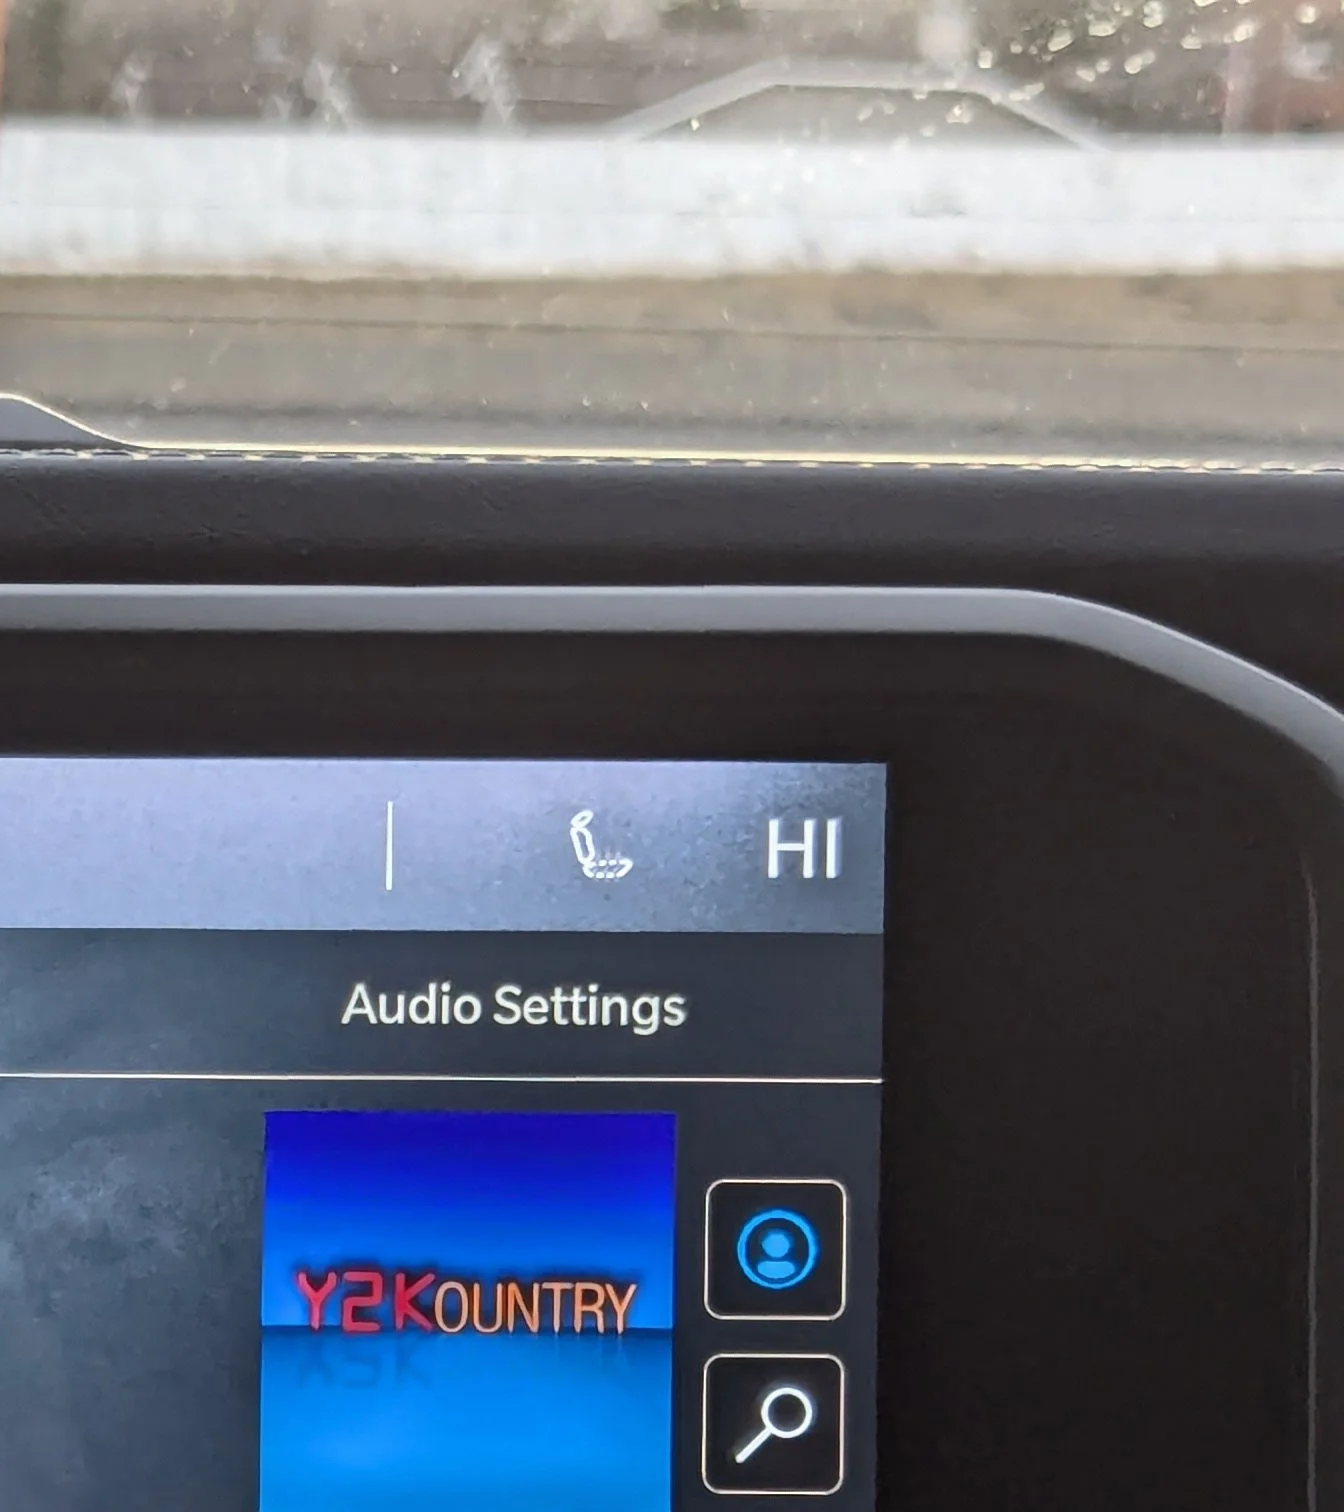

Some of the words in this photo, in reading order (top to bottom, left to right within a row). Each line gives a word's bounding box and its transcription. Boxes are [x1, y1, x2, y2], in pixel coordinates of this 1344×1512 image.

[766, 817, 842, 880] HI
[341, 983, 482, 1027] Audio
[493, 985, 686, 1035] Settings
